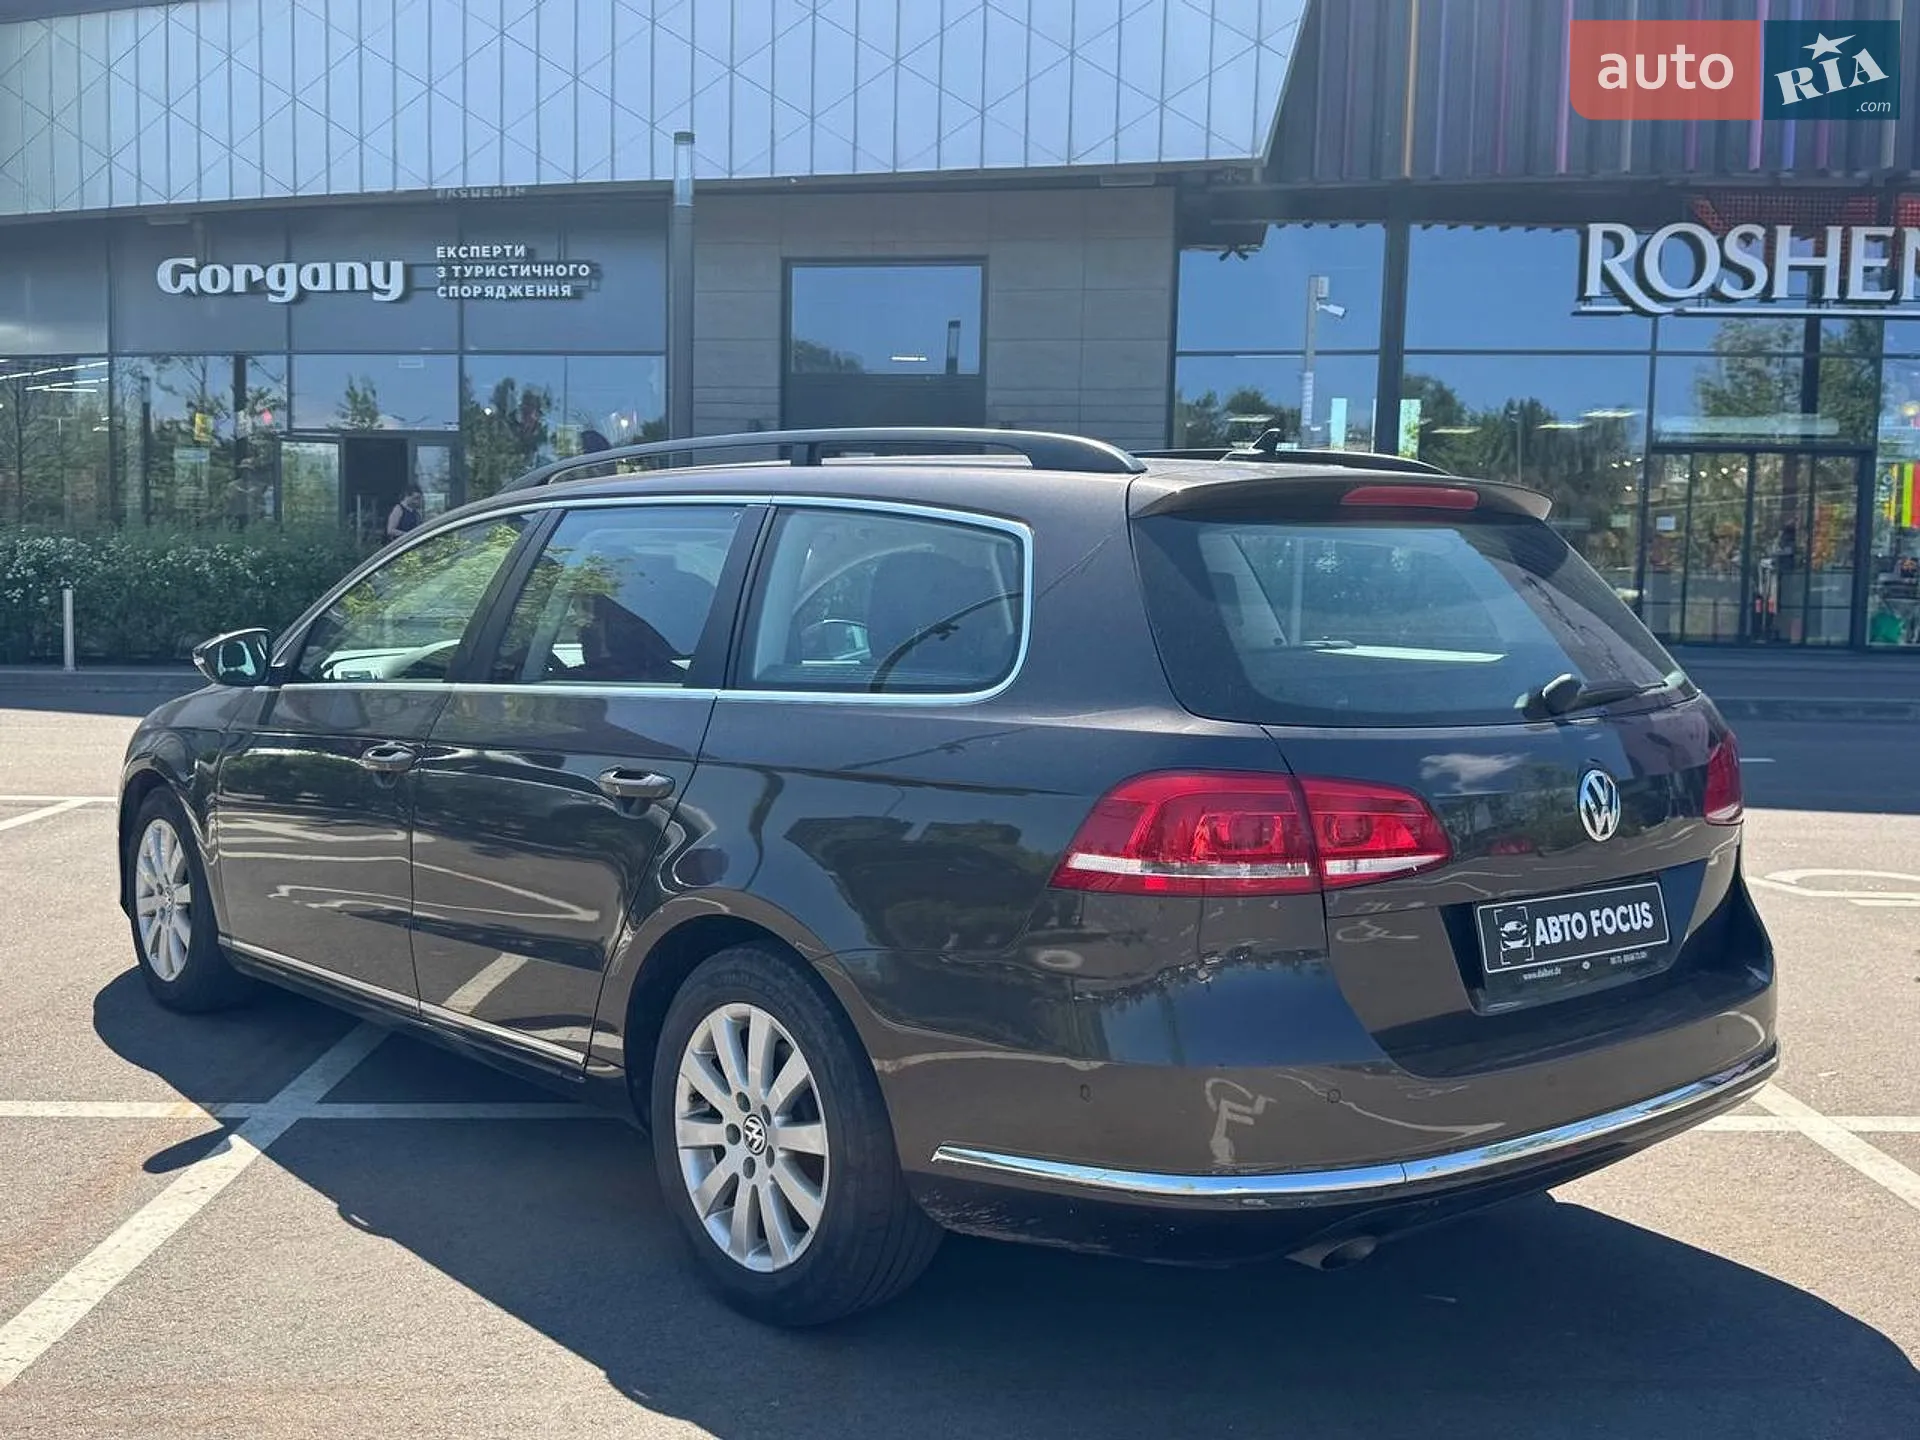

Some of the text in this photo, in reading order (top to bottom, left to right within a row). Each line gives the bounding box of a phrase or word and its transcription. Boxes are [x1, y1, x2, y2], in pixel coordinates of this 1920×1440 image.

[436, 244, 526, 259] ЕКСПЕРТИ
[157, 257, 404, 303] Gorgany
[452, 264, 590, 278] ТУРИСТИЧНОГО
[1584, 222, 1920, 313] ROSHE
[437, 285, 572, 299] СПОРЯДЖЕННЯ
[1590, 901, 1654, 937] FOCUS
